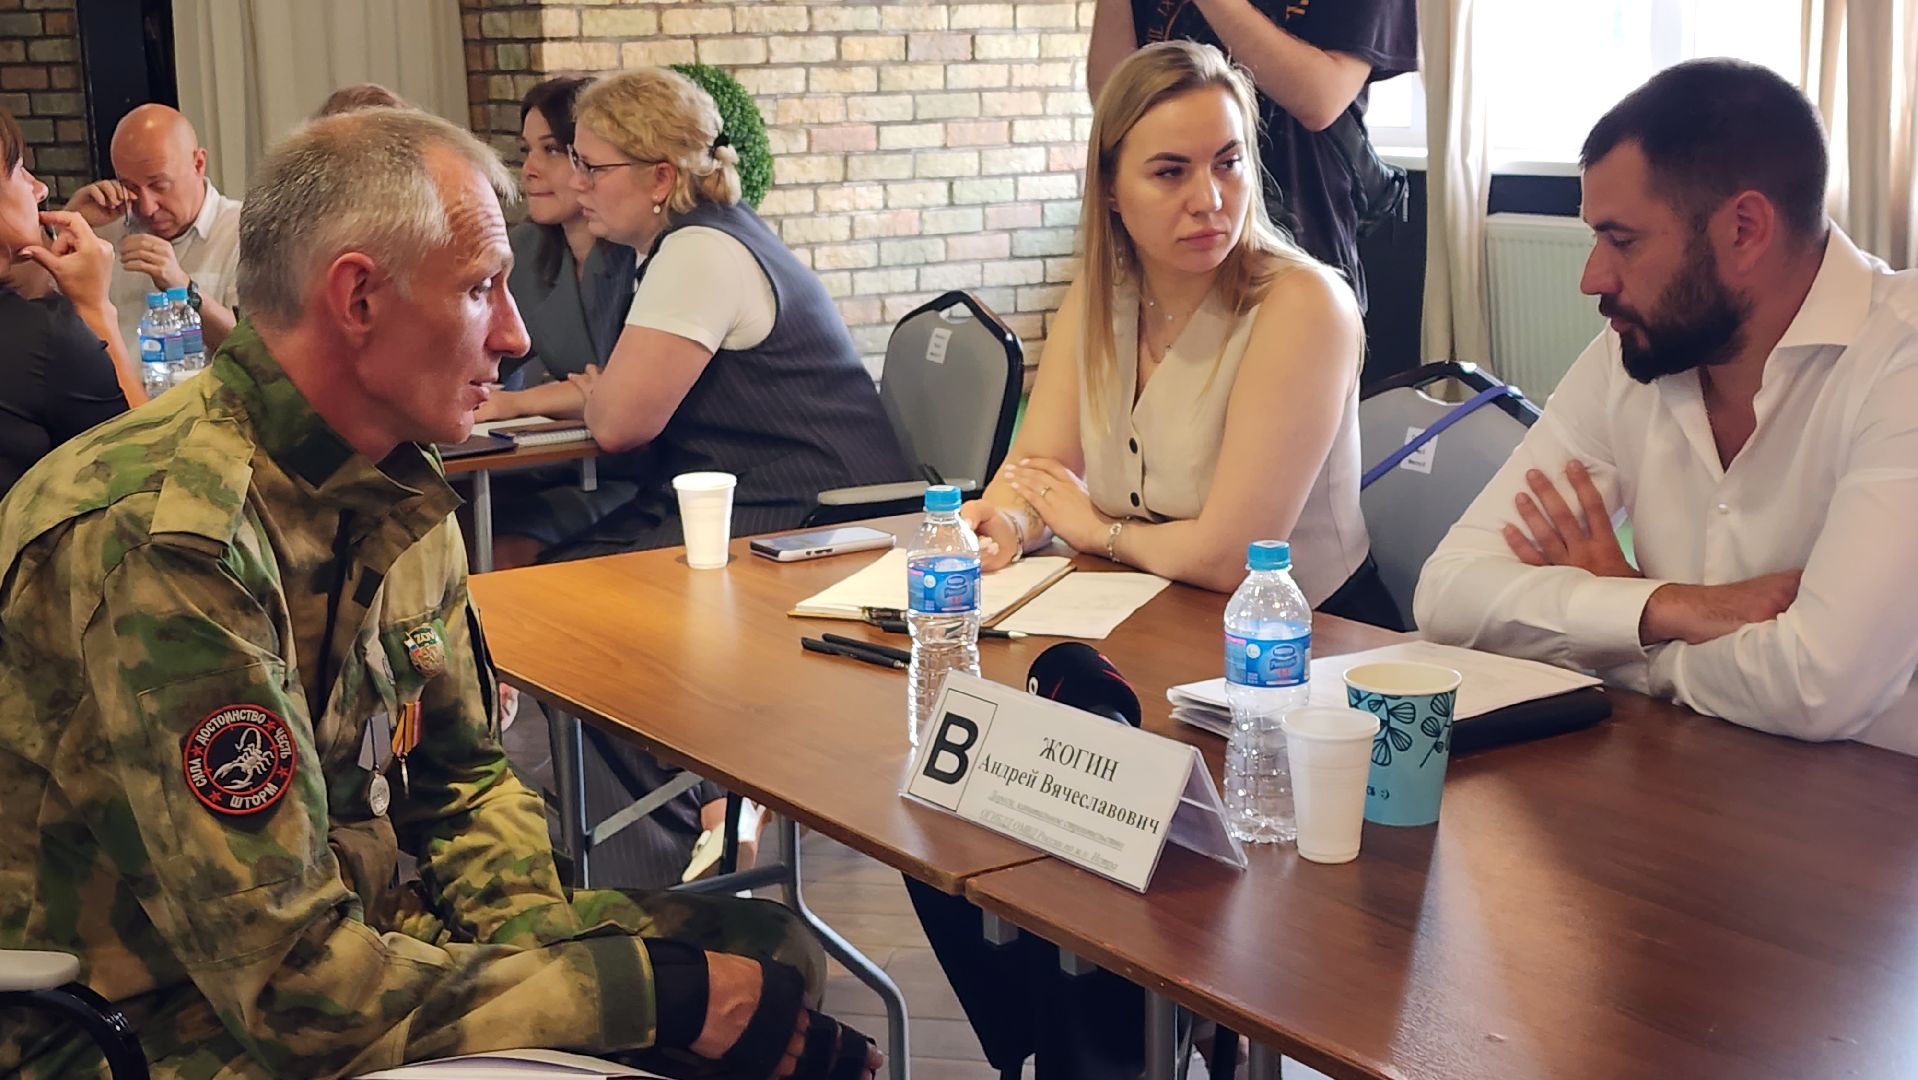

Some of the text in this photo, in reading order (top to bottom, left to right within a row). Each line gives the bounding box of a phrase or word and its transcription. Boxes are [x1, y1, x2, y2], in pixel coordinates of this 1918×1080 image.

[195, 709, 267, 746] ДОСТОИНСТВО
[273, 727, 293, 760] ЧЕСТЬ
[922, 711, 979, 785] В
[1039, 737, 1120, 783] ЖОГИН
[188, 757, 208, 788] СИЛА
[229, 782, 279, 809] ШТОРМ
[978, 753, 1040, 789] Андрей
[1039, 773, 1161, 835] Вячеславович
